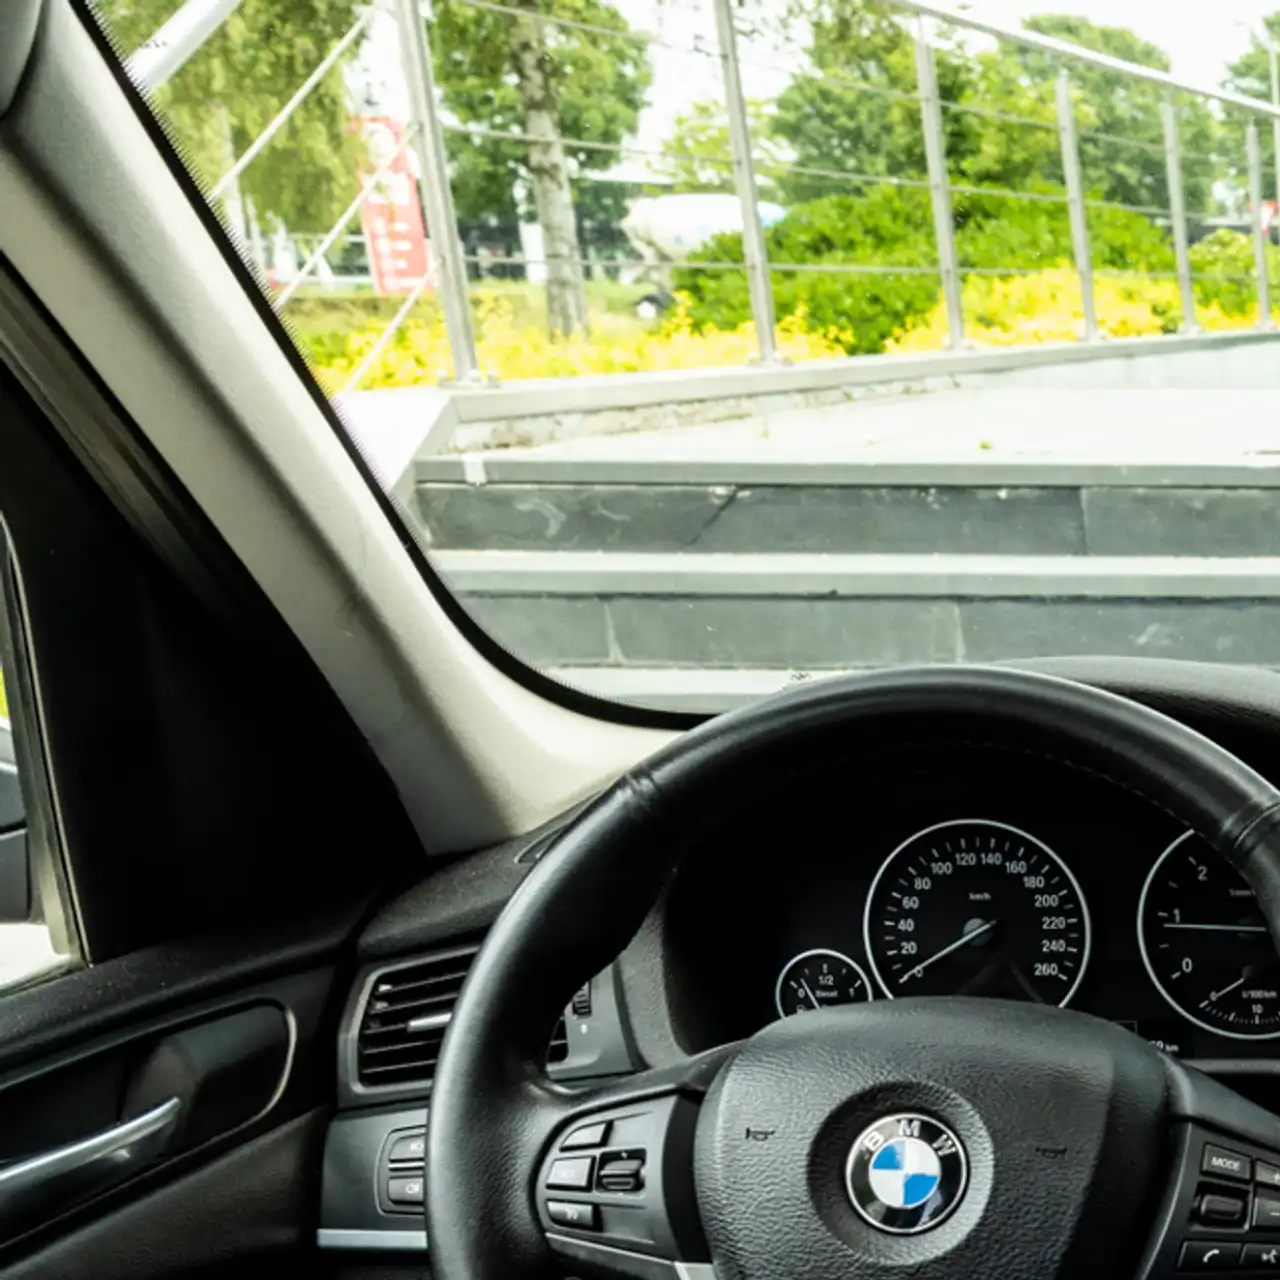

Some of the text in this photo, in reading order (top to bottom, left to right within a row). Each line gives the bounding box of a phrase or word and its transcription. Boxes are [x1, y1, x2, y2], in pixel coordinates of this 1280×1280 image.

[955, 852, 976, 866] 120
[980, 852, 1002, 865] 140
[930, 861, 953, 875] 100
[1005, 860, 1027, 873] 160
[1197, 865, 1208, 881] 2
[914, 876, 931, 890] 80
[1023, 876, 1045, 888] 180
[902, 896, 919, 909] 60
[1034, 894, 1059, 907] 200
[1173, 908, 1180, 923] 1
[898, 918, 915, 931] 40
[1042, 917, 1066, 929] 220
[901, 942, 917, 954] 20
[1041, 939, 1066, 952] 240
[1034, 963, 1058, 976] 260
[1182, 958, 1193, 973] 0
[863, 1119, 956, 1157] BMW
[1211, 1156, 1240, 1171] MODE
